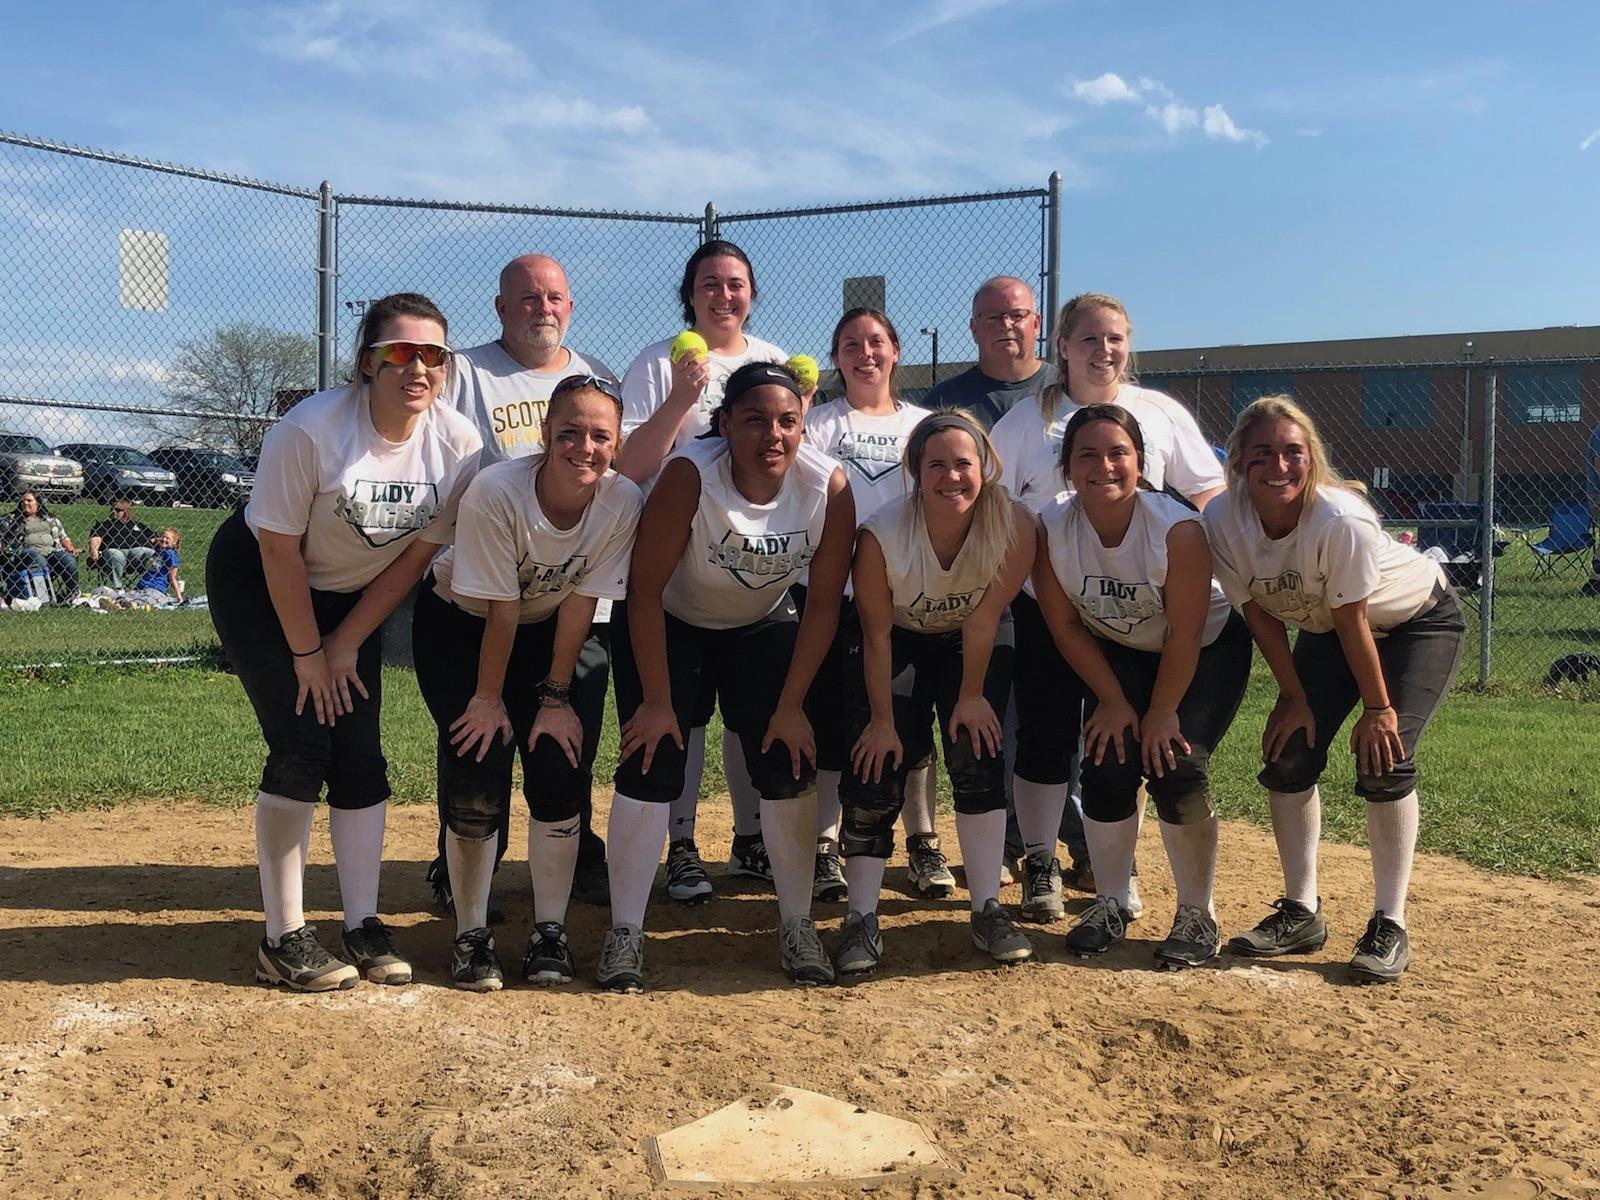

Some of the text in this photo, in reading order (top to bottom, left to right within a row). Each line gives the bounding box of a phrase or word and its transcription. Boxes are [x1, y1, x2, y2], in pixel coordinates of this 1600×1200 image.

[492, 400, 551, 433] SCOT
[856, 434, 898, 446] LADY
[370, 484, 415, 504] LADY
[741, 536, 791, 555] LADY
[1099, 579, 1137, 602] LADY
[924, 593, 974, 613] LADY
